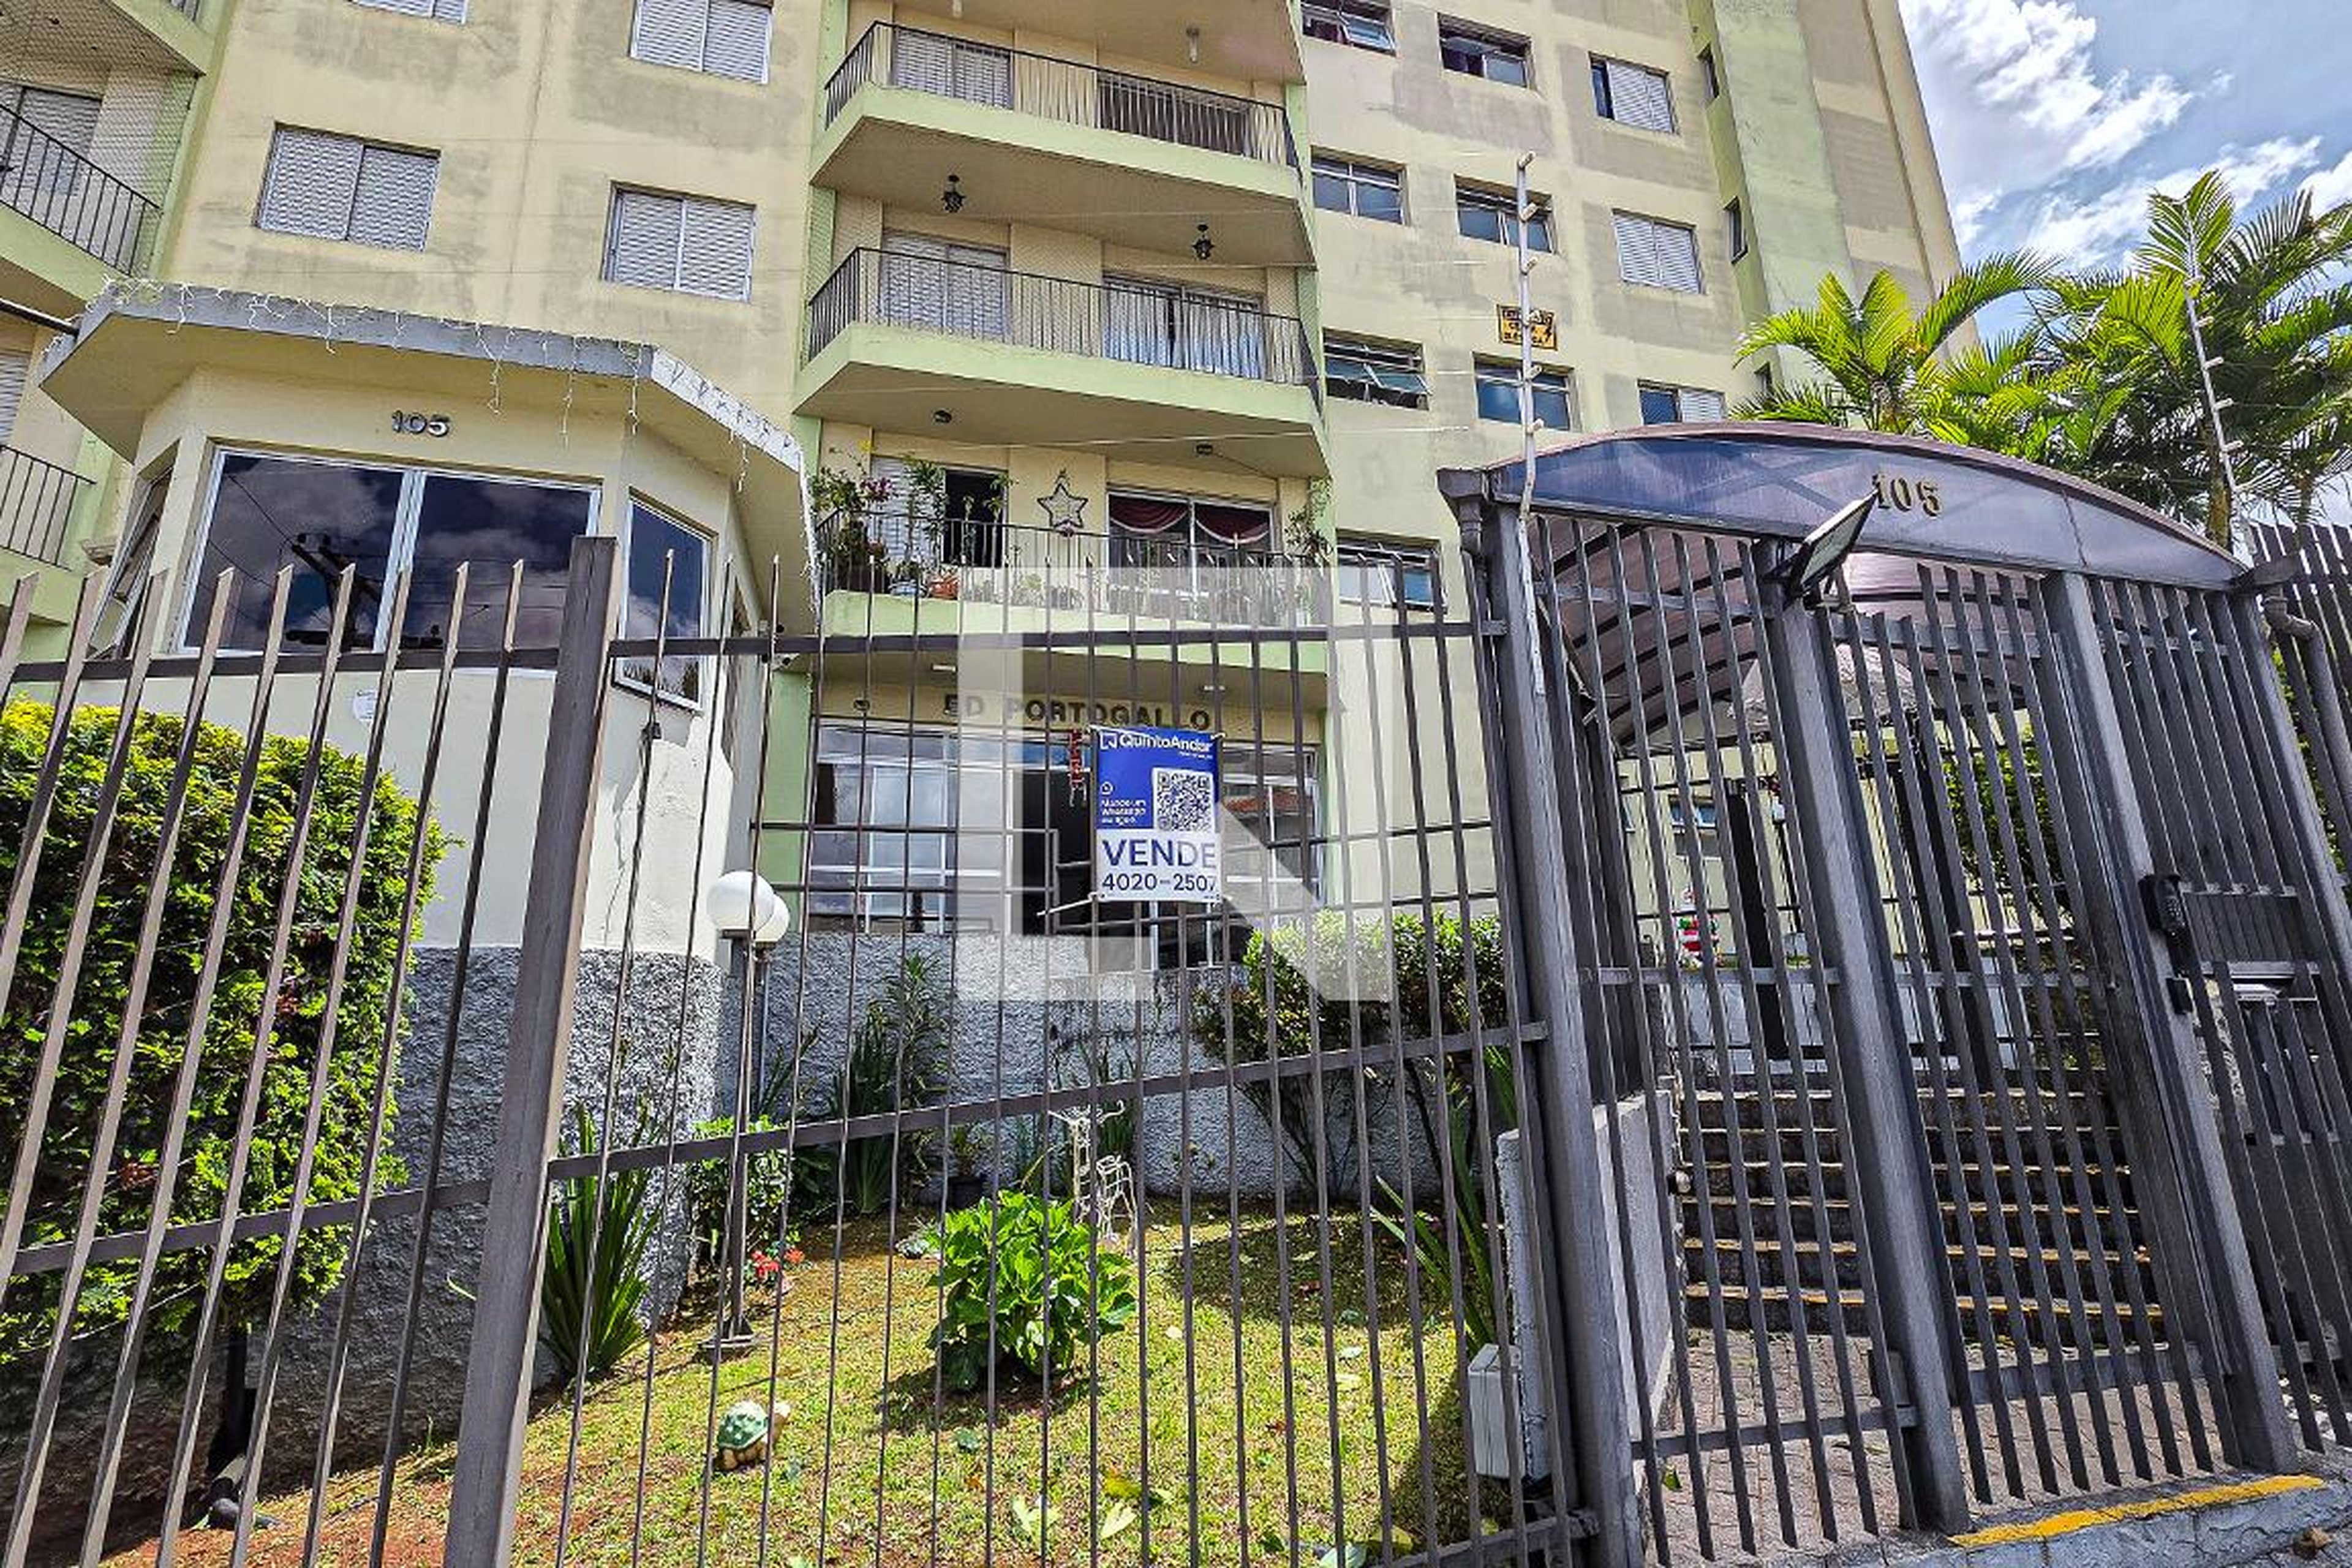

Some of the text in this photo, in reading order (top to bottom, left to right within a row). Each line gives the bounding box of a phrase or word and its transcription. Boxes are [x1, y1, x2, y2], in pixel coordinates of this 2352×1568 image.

[392, 410, 450, 437] 105
[1872, 473, 1940, 517] 105
[1120, 734, 1213, 752] QuintoAndar
[1102, 839, 1216, 868] VENDE
